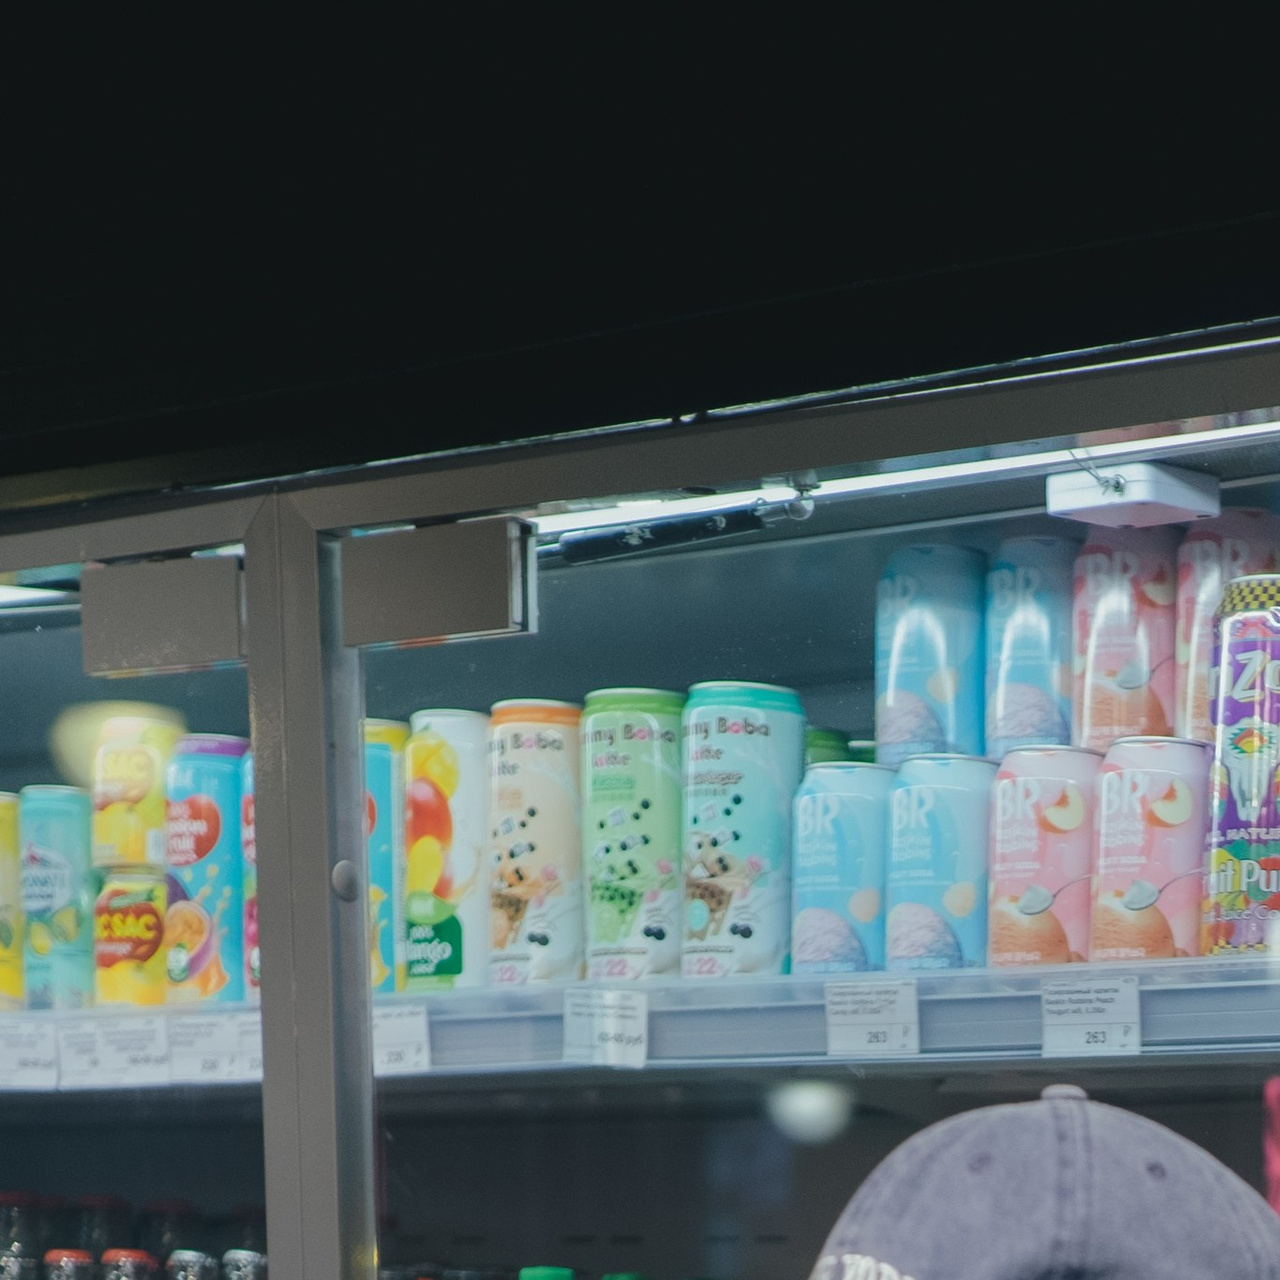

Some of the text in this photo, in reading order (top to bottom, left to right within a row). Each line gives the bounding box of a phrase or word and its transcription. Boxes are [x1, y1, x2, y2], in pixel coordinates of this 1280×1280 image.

[623, 724, 676, 744] Boba
[717, 717, 771, 737] Boba
[512, 732, 563, 752] Boba
[998, 779, 1040, 821] BR
